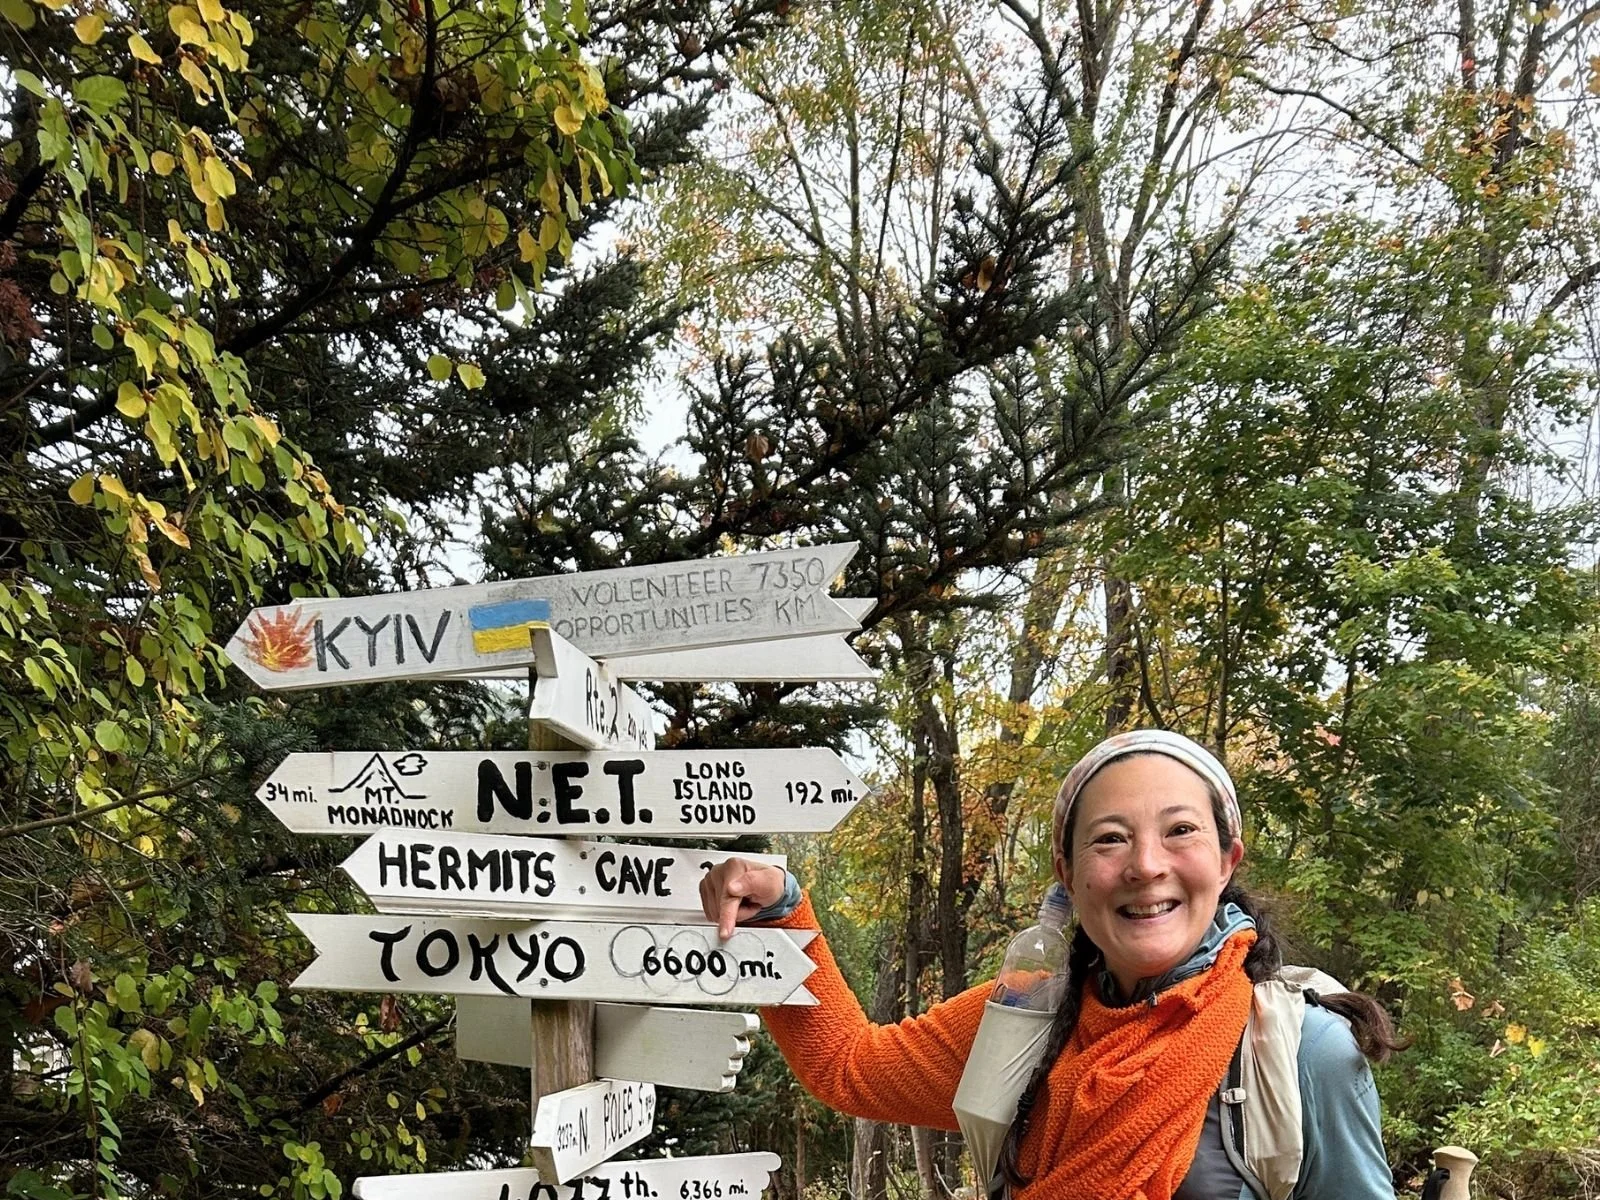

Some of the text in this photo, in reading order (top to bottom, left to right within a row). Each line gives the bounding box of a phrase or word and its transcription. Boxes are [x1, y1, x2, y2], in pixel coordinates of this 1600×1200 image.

[751, 557, 825, 590] 7350
[555, 598, 753, 640] OPPORTUNITIES
[314, 609, 451, 671] KYIV
[686, 761, 745, 779] LONG
[265, 782, 317, 803] 34 mi.
[364, 786, 400, 804] MT.
[477, 758, 653, 825] N.E.T.
[673, 779, 753, 801] ISLAND
[785, 780, 859, 805] 192 mi.
[327, 805, 454, 829] MONADNOCK
[679, 803, 756, 825] SOUND
[378, 841, 675, 897] HERMITS CAVE
[368, 924, 782, 998] TOKYO 6600 mi.
[729, 1179, 749, 1195] mi.
